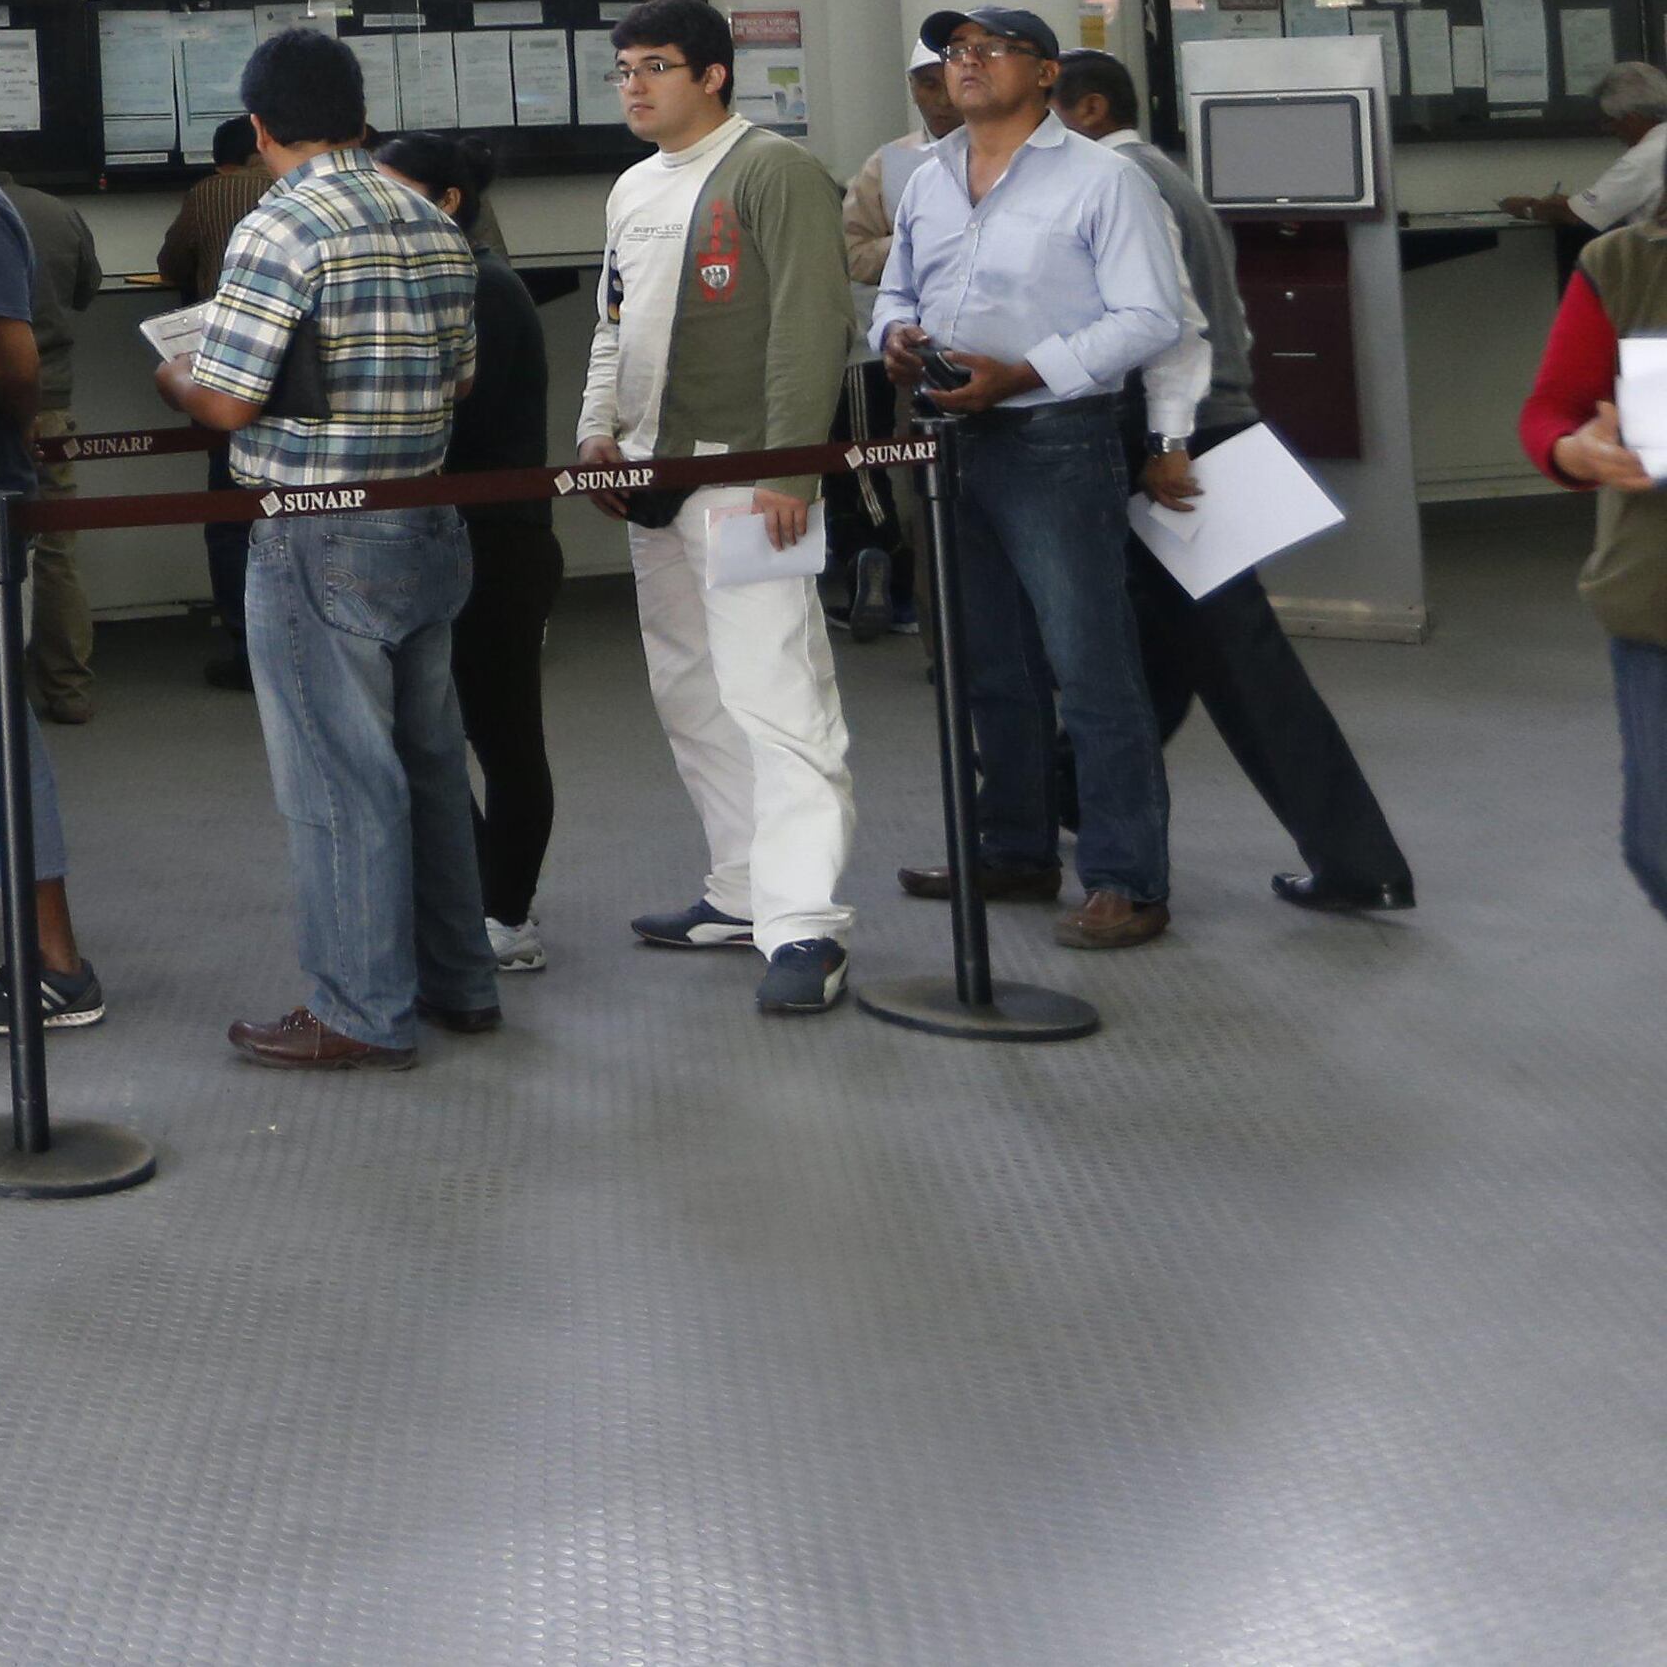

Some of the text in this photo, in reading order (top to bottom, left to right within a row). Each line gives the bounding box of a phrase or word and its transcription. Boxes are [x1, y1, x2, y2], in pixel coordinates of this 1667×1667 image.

[83, 436, 152, 454] SUNARP
[577, 468, 653, 489] SUNARP
[283, 489, 365, 511] SUNARP
